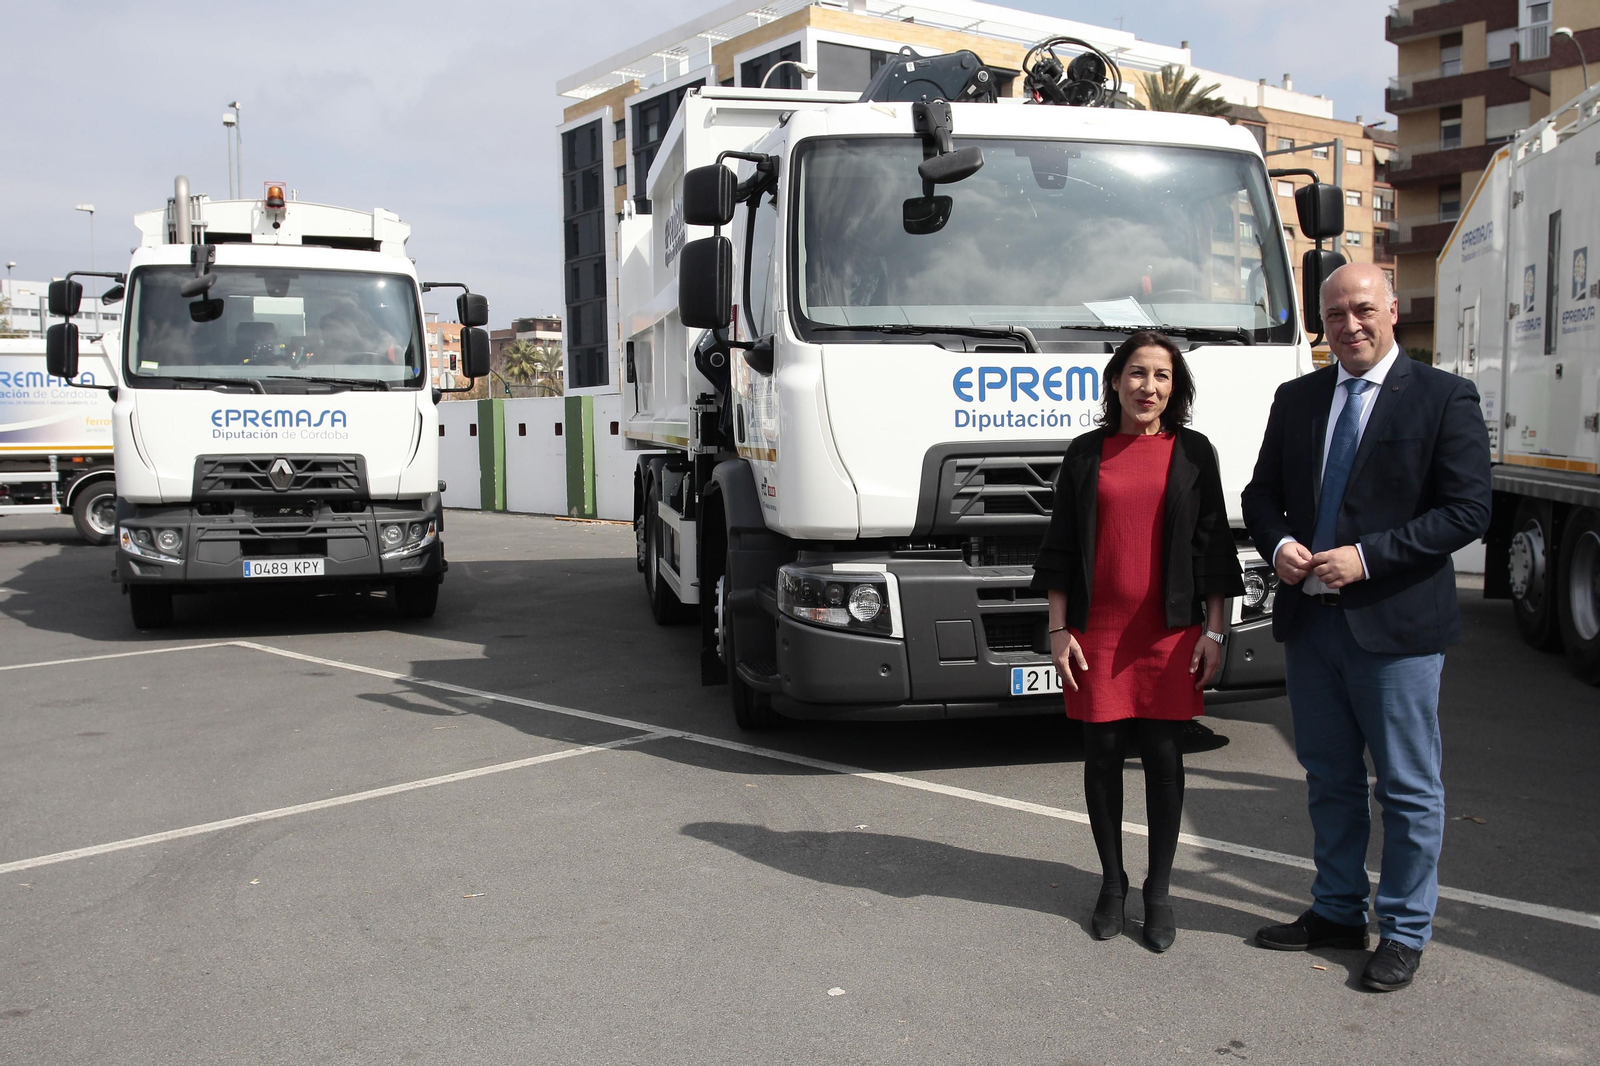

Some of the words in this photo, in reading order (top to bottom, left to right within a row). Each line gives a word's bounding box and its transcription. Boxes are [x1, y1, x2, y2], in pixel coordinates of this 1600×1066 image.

[953, 366, 1099, 402] EPREM
[32, 389, 47, 399] de
[51, 388, 98, 399] Córdoba
[211, 409, 347, 428] EPREMASA
[955, 409, 1072, 432] Diputación
[212, 429, 278, 441] Diputación
[281, 429, 297, 440] de
[300, 429, 349, 440] Córdoba
[254, 562, 289, 576] 0489
[294, 561, 319, 574] KPY
